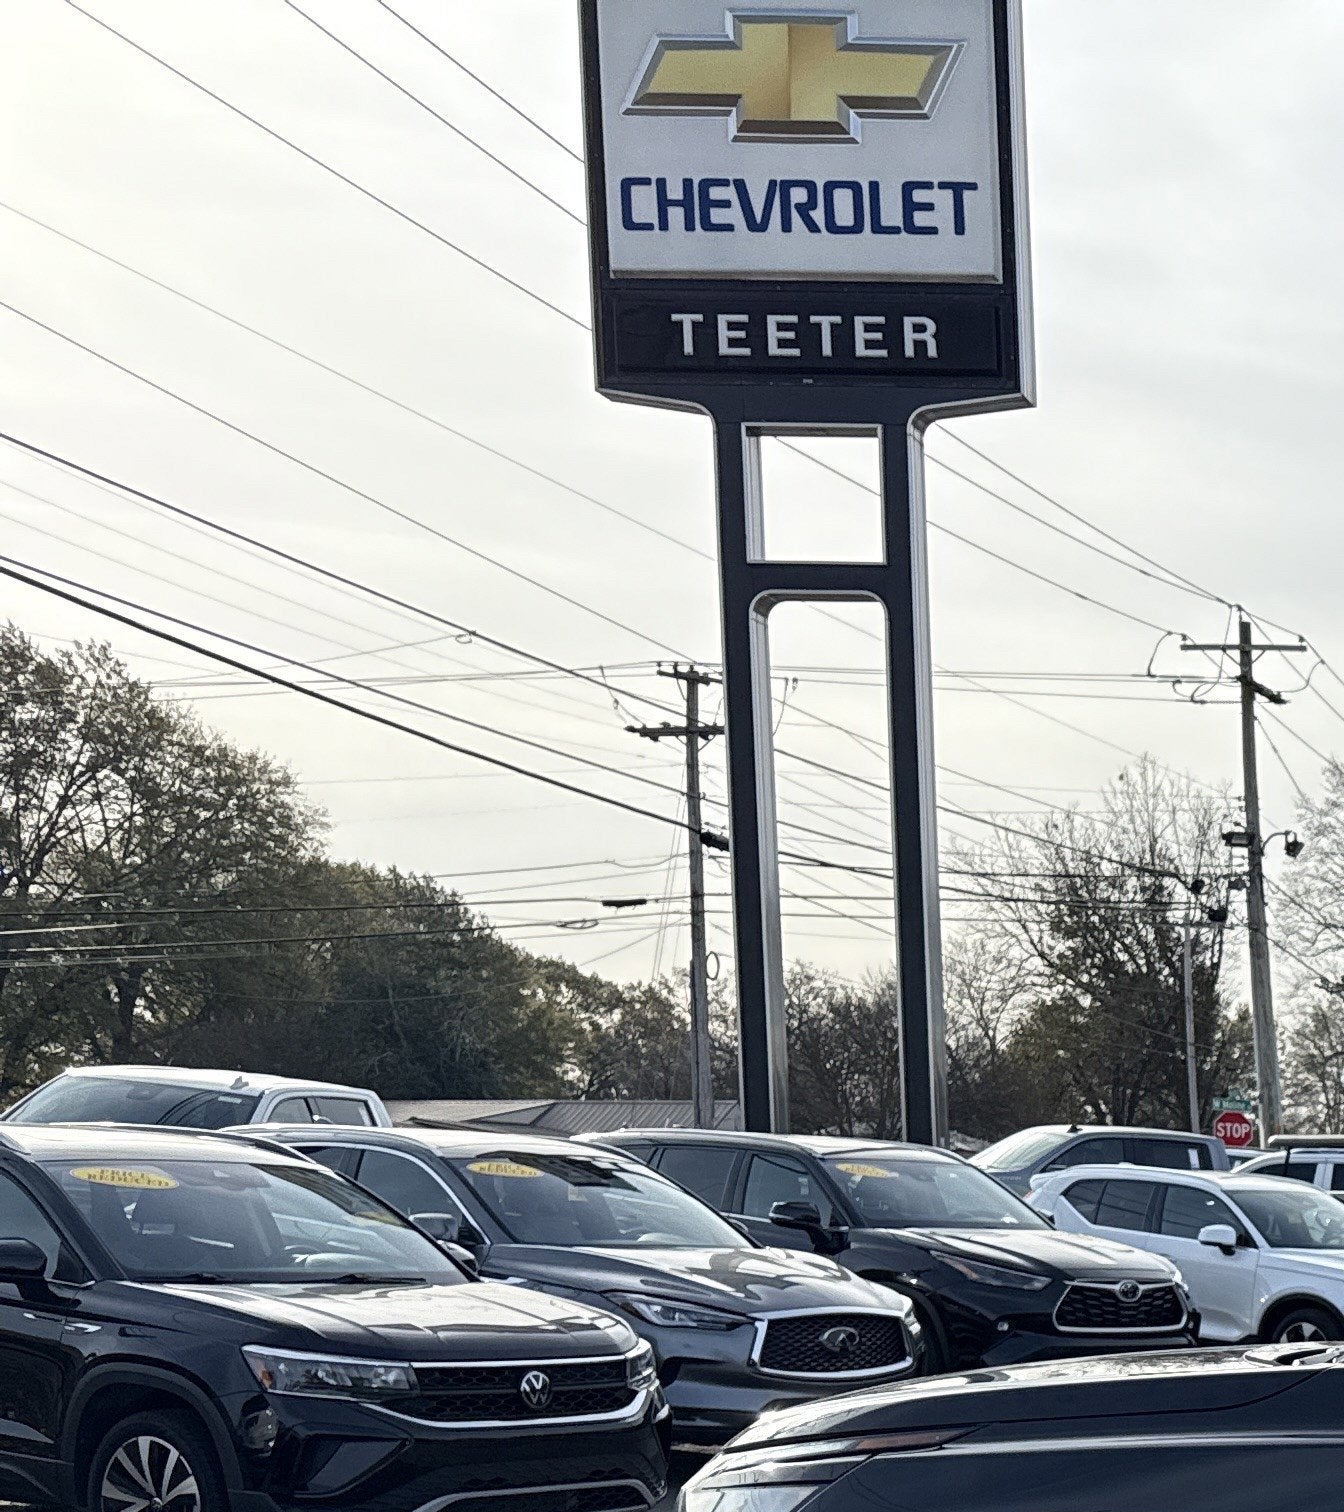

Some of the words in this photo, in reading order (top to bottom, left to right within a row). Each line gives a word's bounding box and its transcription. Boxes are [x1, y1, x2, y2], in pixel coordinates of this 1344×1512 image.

[619, 176, 979, 236] CHEVROLET
[670, 312, 940, 359] TEETER
[1216, 1122, 1251, 1139] STOP
